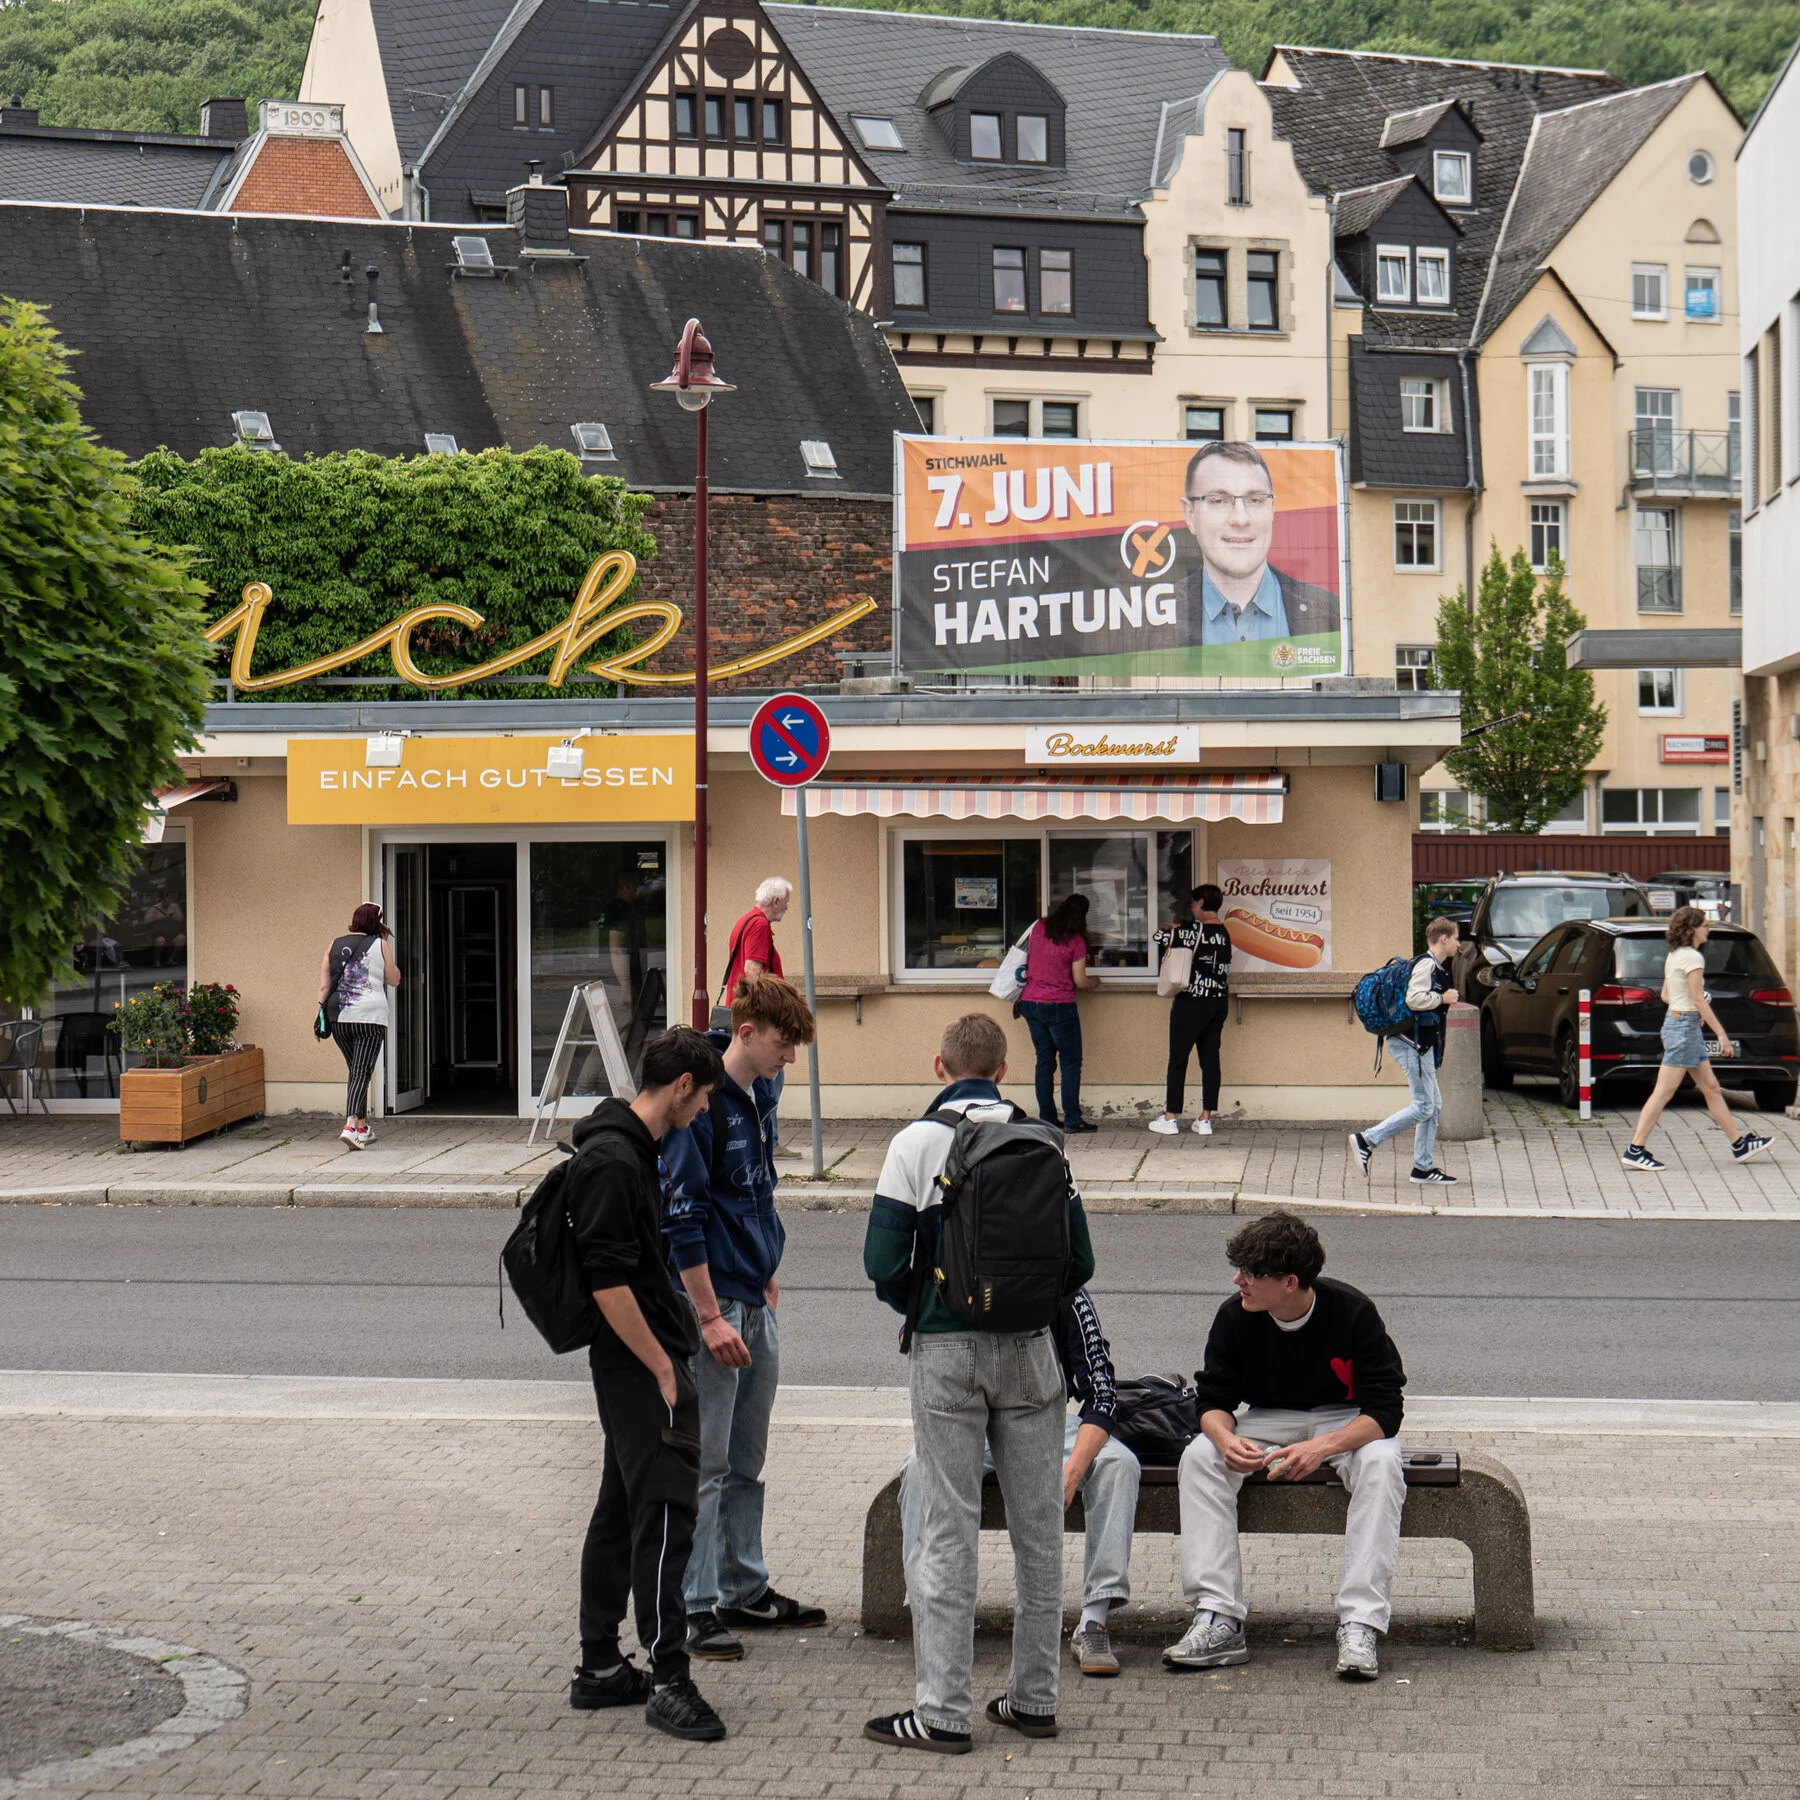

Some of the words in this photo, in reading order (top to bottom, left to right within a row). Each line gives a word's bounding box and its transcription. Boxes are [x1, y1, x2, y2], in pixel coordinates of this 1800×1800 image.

[283, 110, 325, 126] 1900
[925, 453, 1008, 471] STICHWAHL
[927, 474, 970, 528] 7.
[985, 461, 1114, 525] JUNI
[933, 556, 1050, 593] STEFAN
[934, 583, 1177, 646] HARTUNG
[1297, 647, 1321, 656] FREIE
[1297, 655, 1336, 664] SACHSEN
[1045, 732, 1178, 757] Bockwurst
[319, 769, 467, 789] EINFACH
[479, 768, 549, 788] GUT
[1222, 877, 1328, 897] Bockwurst
[1274, 905, 1292, 917] seit
[1295, 907, 1317, 920] 1954
